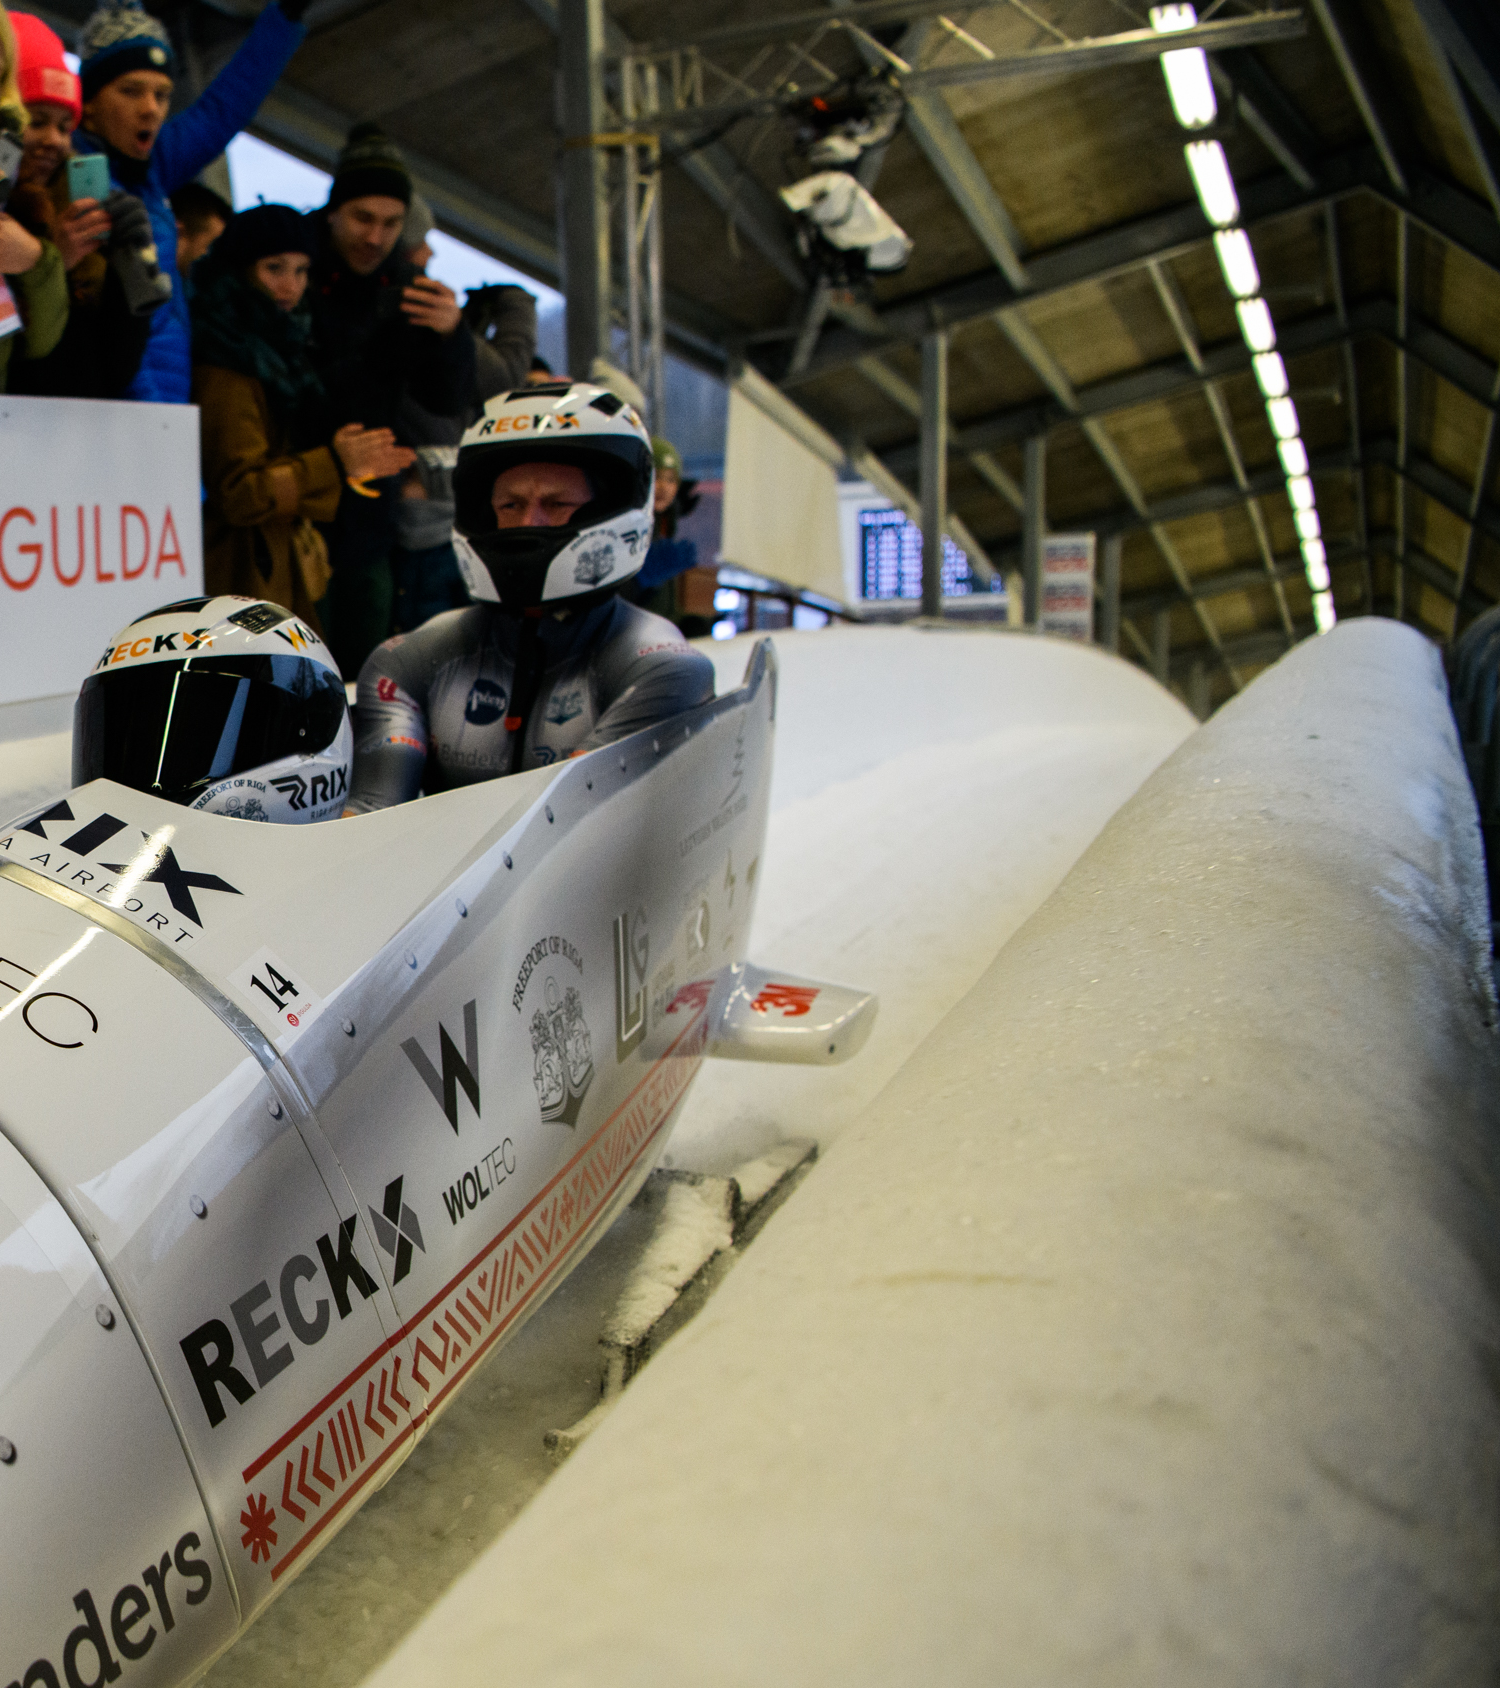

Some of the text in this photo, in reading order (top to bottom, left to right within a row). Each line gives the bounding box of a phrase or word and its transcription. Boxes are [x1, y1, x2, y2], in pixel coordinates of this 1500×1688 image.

[311, 763, 348, 807] RIX
[250, 962, 300, 1013] 14
[442, 1137, 516, 1226] WOLTEC
